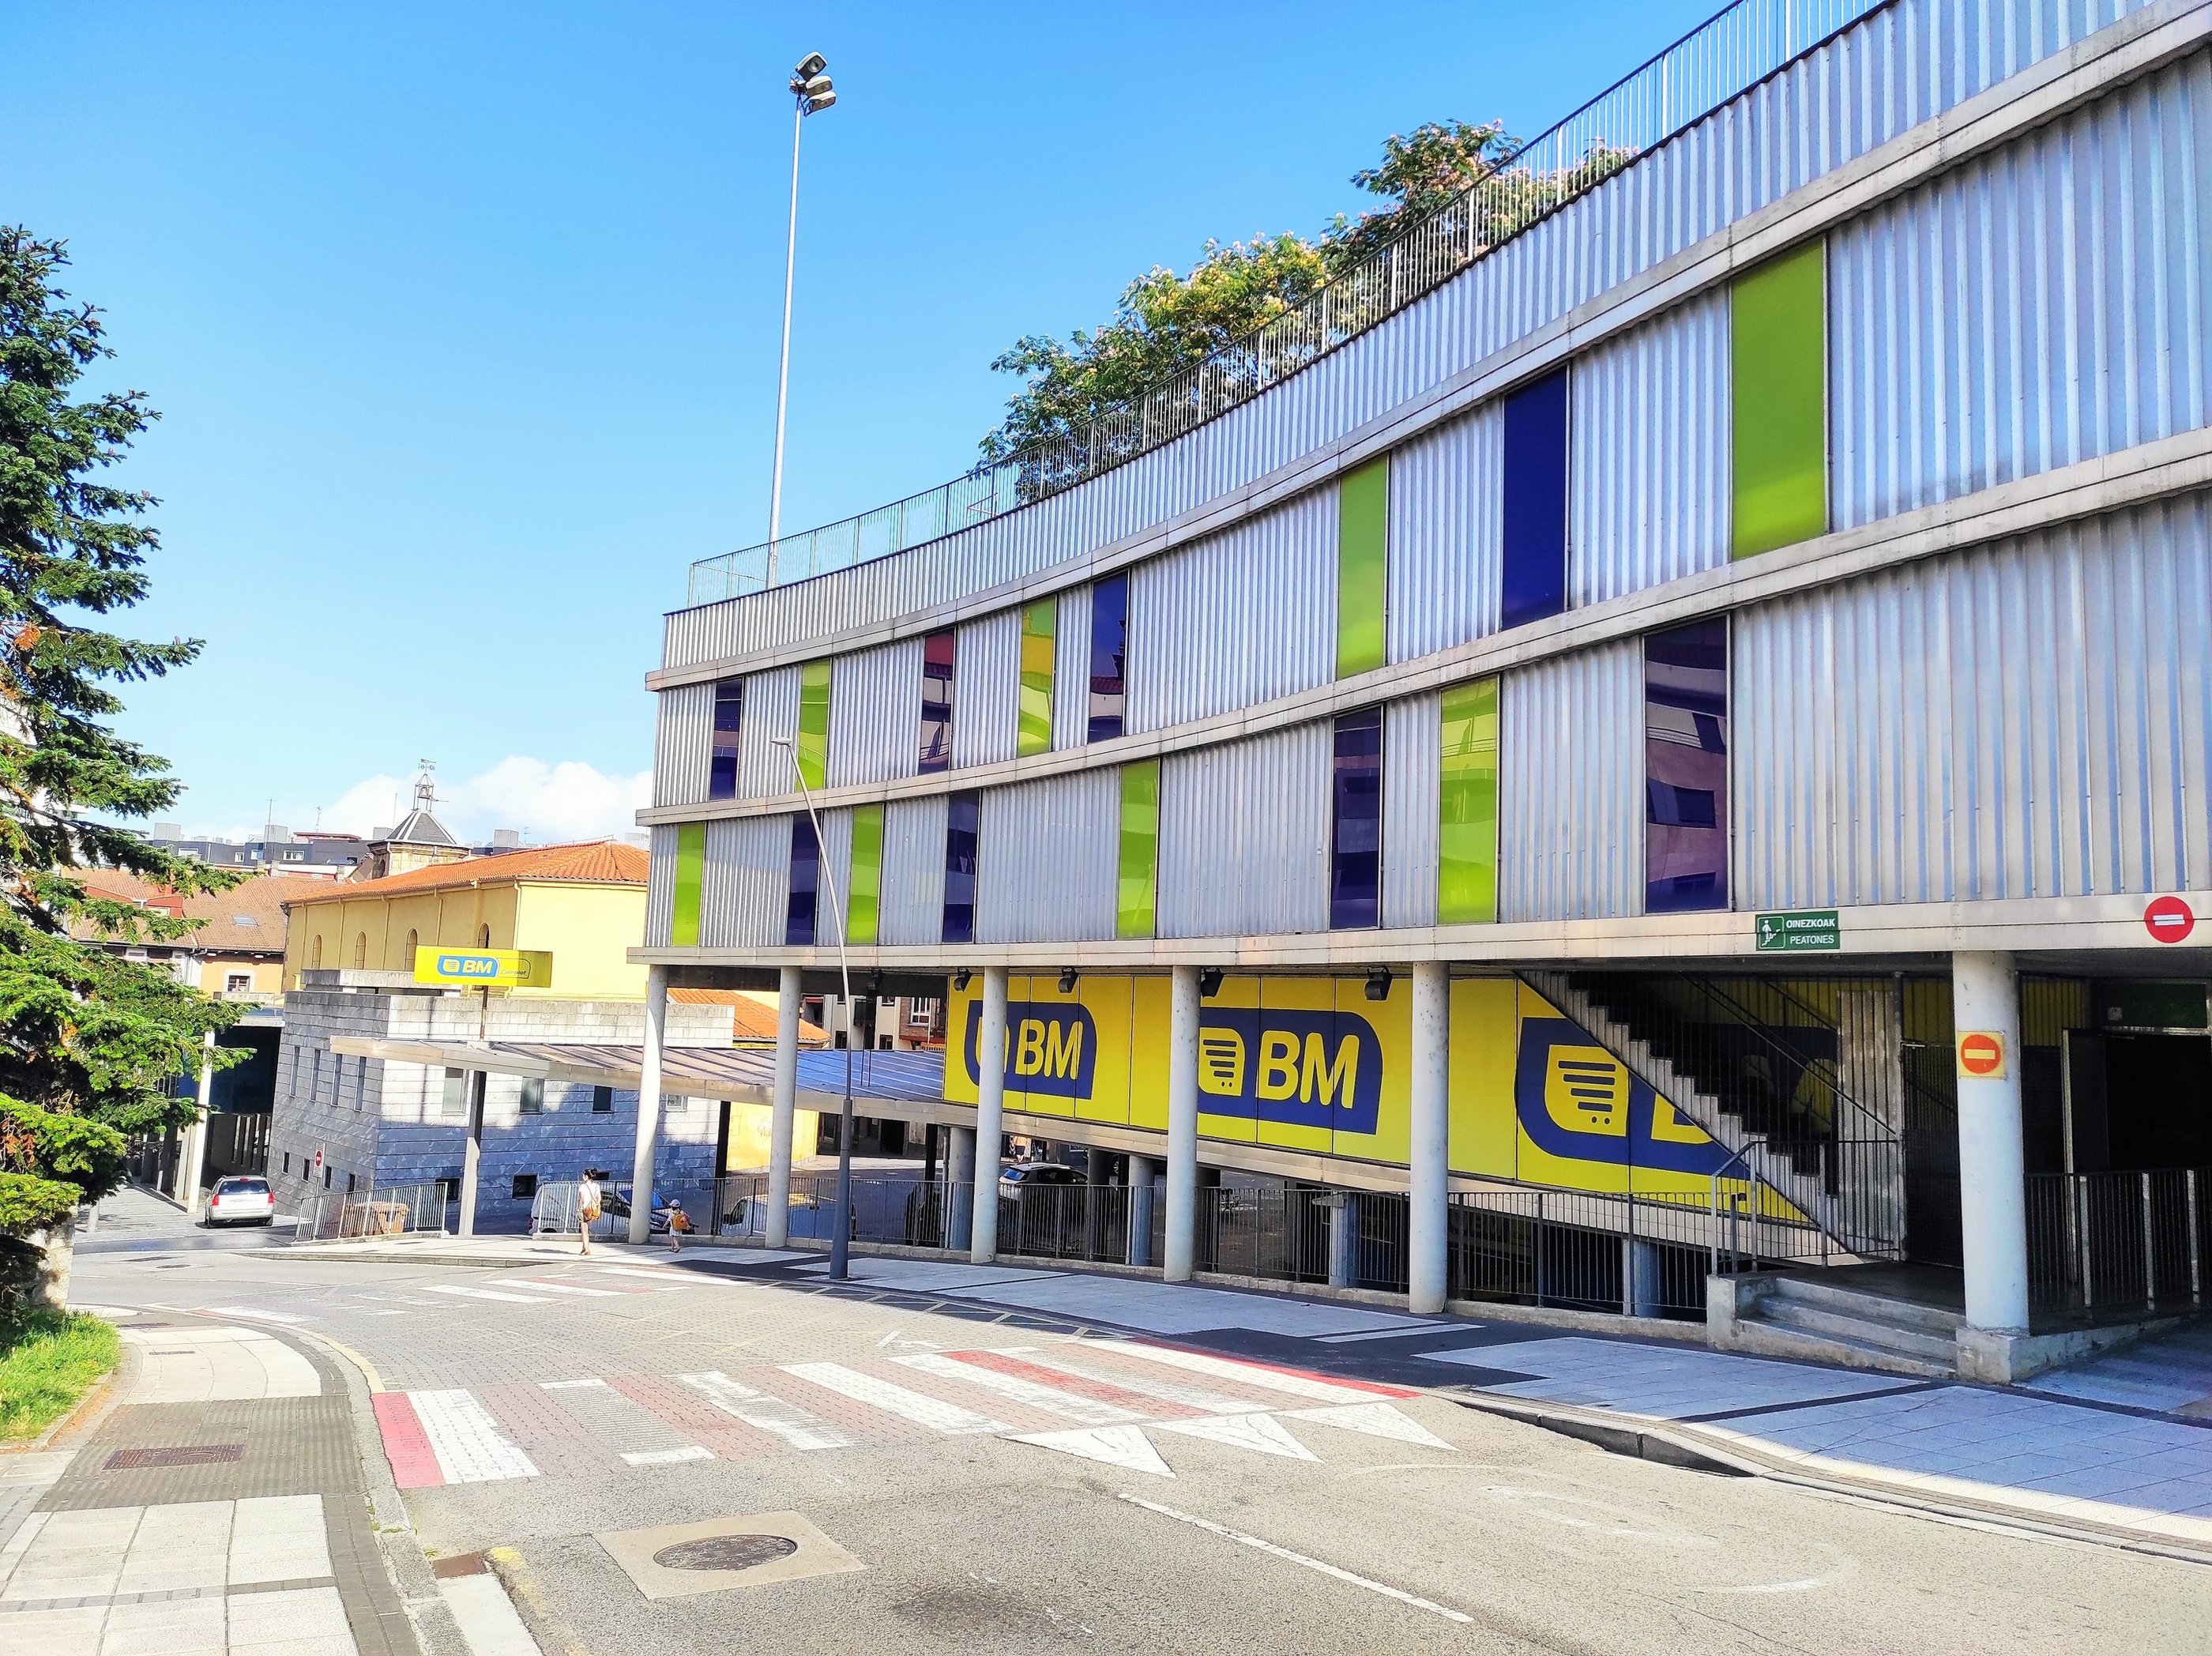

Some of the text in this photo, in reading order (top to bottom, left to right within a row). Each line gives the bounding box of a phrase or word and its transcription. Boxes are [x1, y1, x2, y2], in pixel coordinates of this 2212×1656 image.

[1786, 918, 1835, 928] OINEZKOAK
[1789, 935, 1834, 944] PEATONES
[462, 959, 492, 974] BM
[1015, 1018, 1083, 1080] BM
[1255, 1029, 1360, 1109] BM
